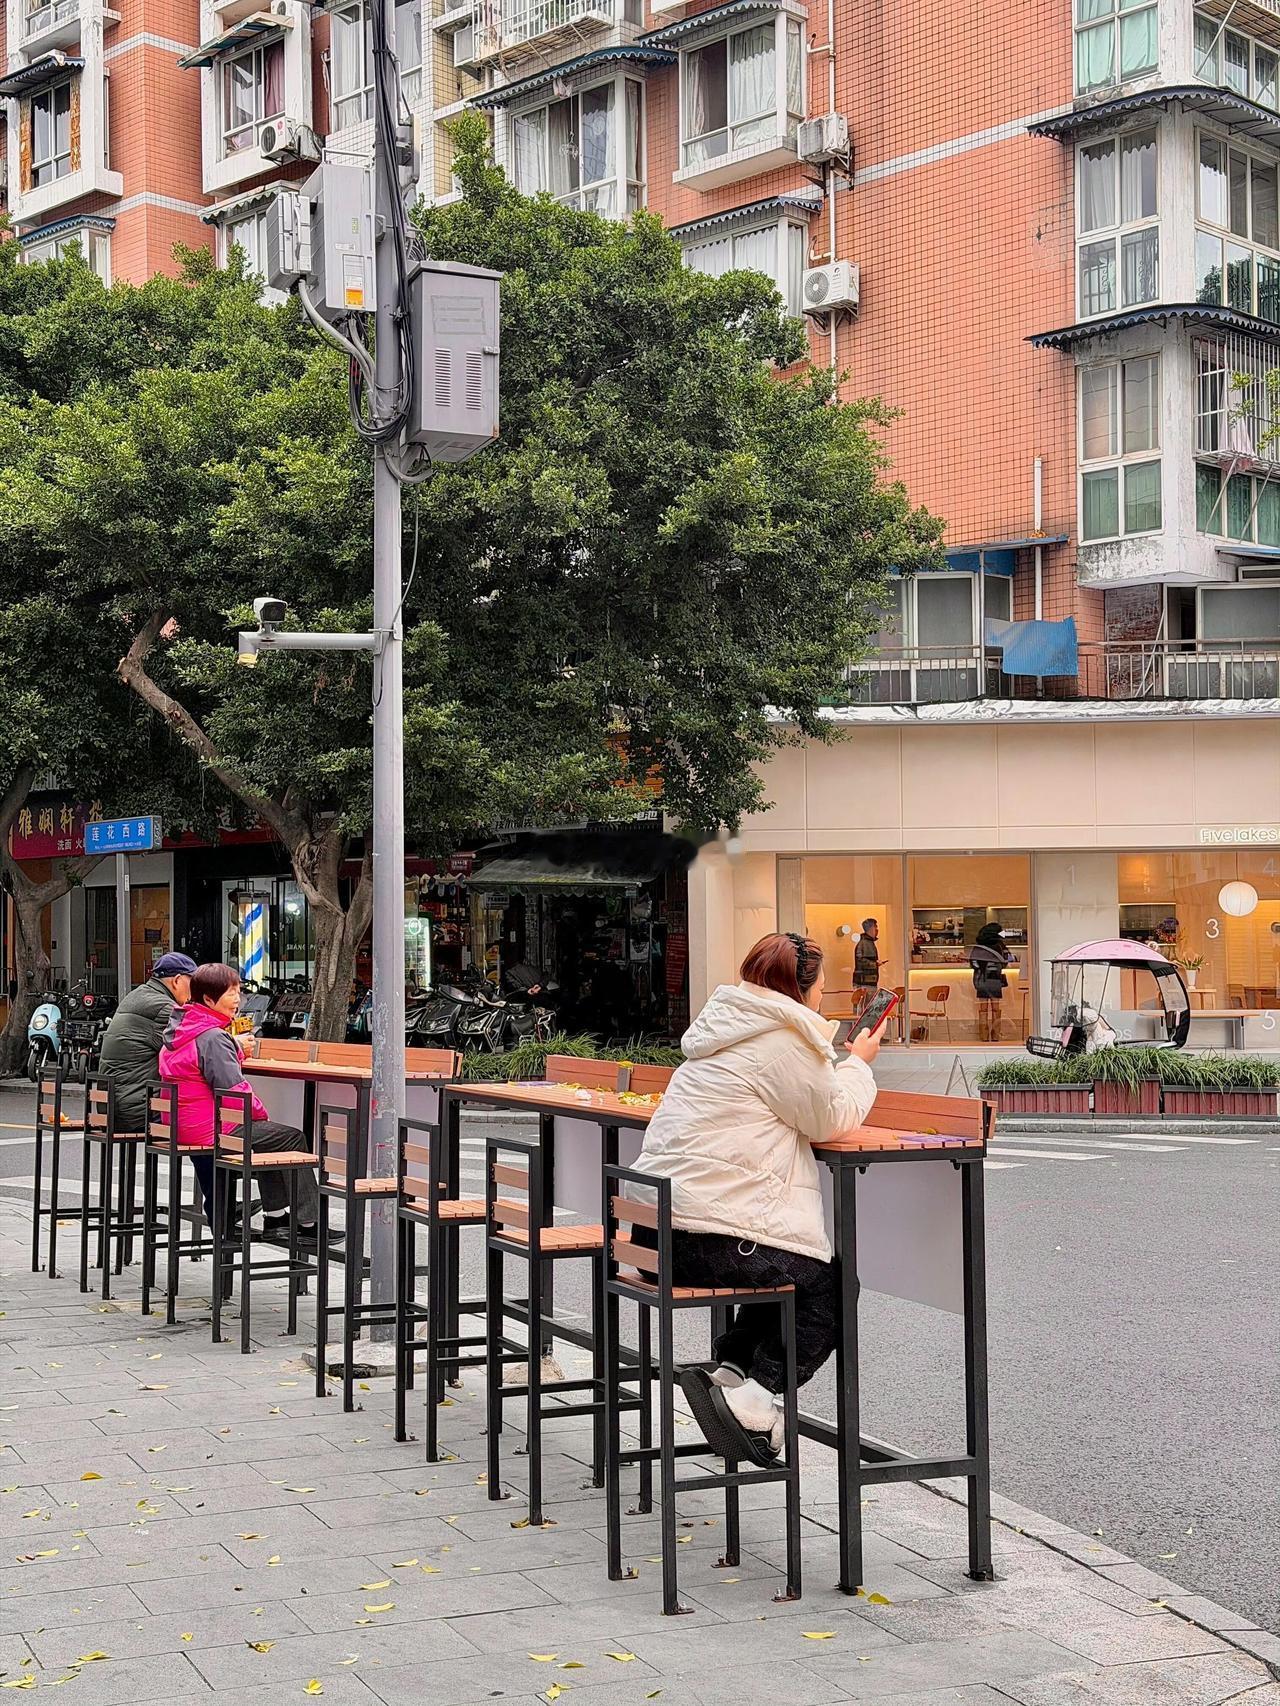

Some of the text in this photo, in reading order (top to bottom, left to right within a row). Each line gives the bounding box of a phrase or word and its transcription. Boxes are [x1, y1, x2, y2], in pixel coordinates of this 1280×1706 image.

[91, 822, 146, 842] 莲花西路
[1201, 828, 1278, 842] Five lakes
[1205, 918, 1220, 939] 3
[1261, 1010, 1276, 1030] 5
